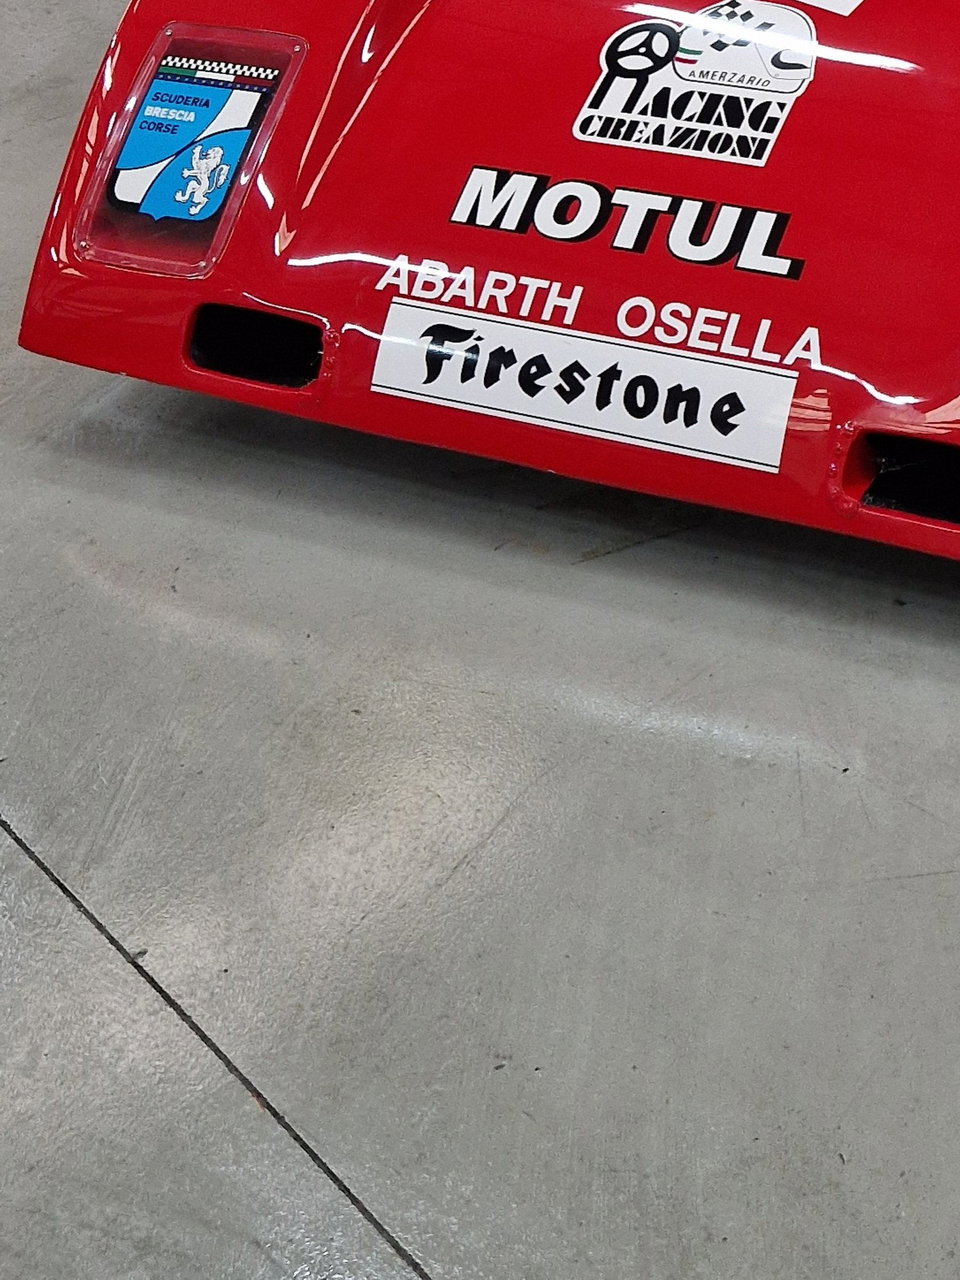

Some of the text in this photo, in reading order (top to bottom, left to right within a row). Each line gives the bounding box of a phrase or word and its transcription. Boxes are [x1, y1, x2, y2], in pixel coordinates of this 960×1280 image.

[143, 105, 196, 123] BRESCIA
[151, 91, 211, 110] SCUDERIA
[138, 119, 179, 136] CORSE
[578, 114, 771, 161] CREAZIONI
[450, 166, 803, 280] MOTUL
[374, 253, 824, 366] ABARTH OSELLA
[418, 322, 747, 437] Firestone
